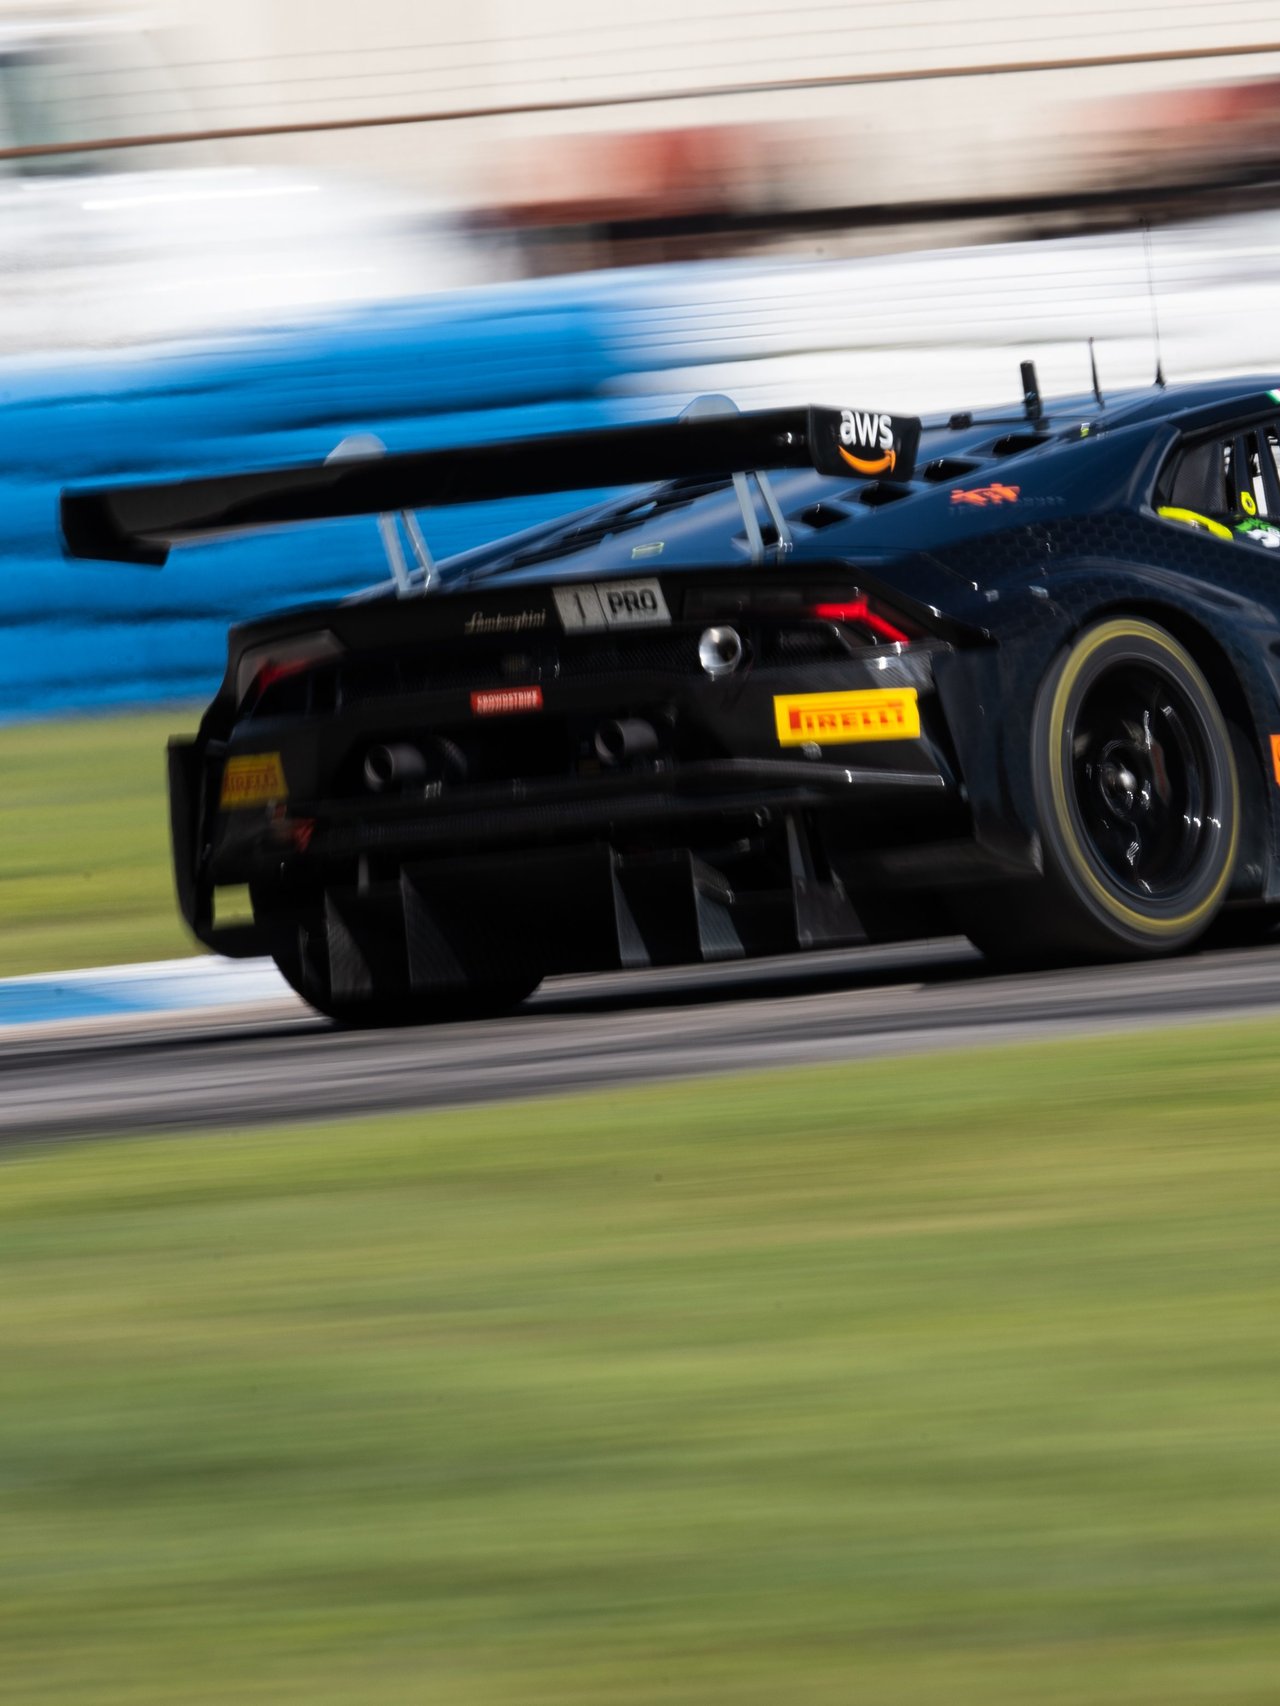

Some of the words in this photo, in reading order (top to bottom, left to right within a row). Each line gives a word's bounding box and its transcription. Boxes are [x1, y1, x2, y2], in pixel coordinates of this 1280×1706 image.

[839, 410, 894, 449] aws
[606, 588, 659, 616] PRO
[476, 690, 538, 710] CROWDSTRIKE
[788, 700, 905, 736] PIRELLI
